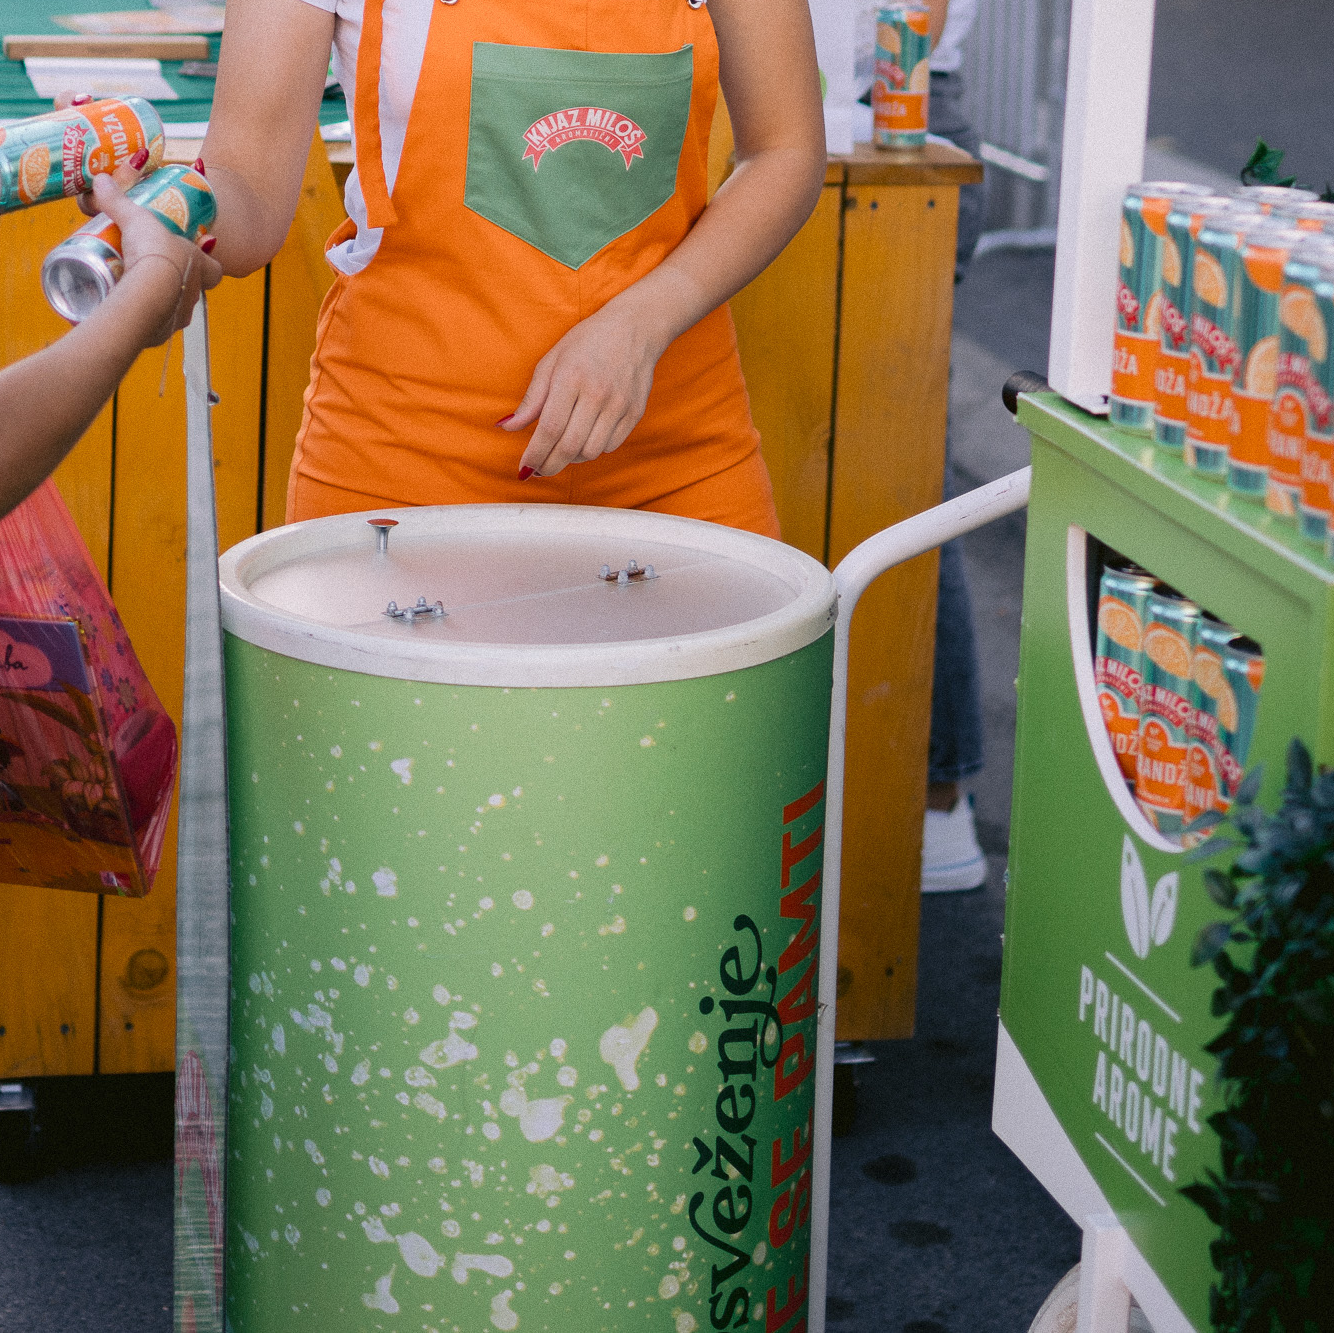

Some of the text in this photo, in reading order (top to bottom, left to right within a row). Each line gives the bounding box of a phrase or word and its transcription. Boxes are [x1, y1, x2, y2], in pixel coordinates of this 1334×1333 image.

[63, 125, 80, 172] MILOŠ
[101, 112, 130, 166] ANDŽA
[527, 108, 643, 146] KNJAZ MILOŠ
[555, 128, 616, 146] AROMATIČNI
[1107, 659, 1142, 688] MILO
[1154, 686, 1192, 717] MILO
[765, 777, 826, 1333] E SE PAMTI
[1078, 964, 1205, 1135] PRIRODNE
[688, 913, 783, 1333] sveženje
[1092, 1049, 1179, 1183] AROME
